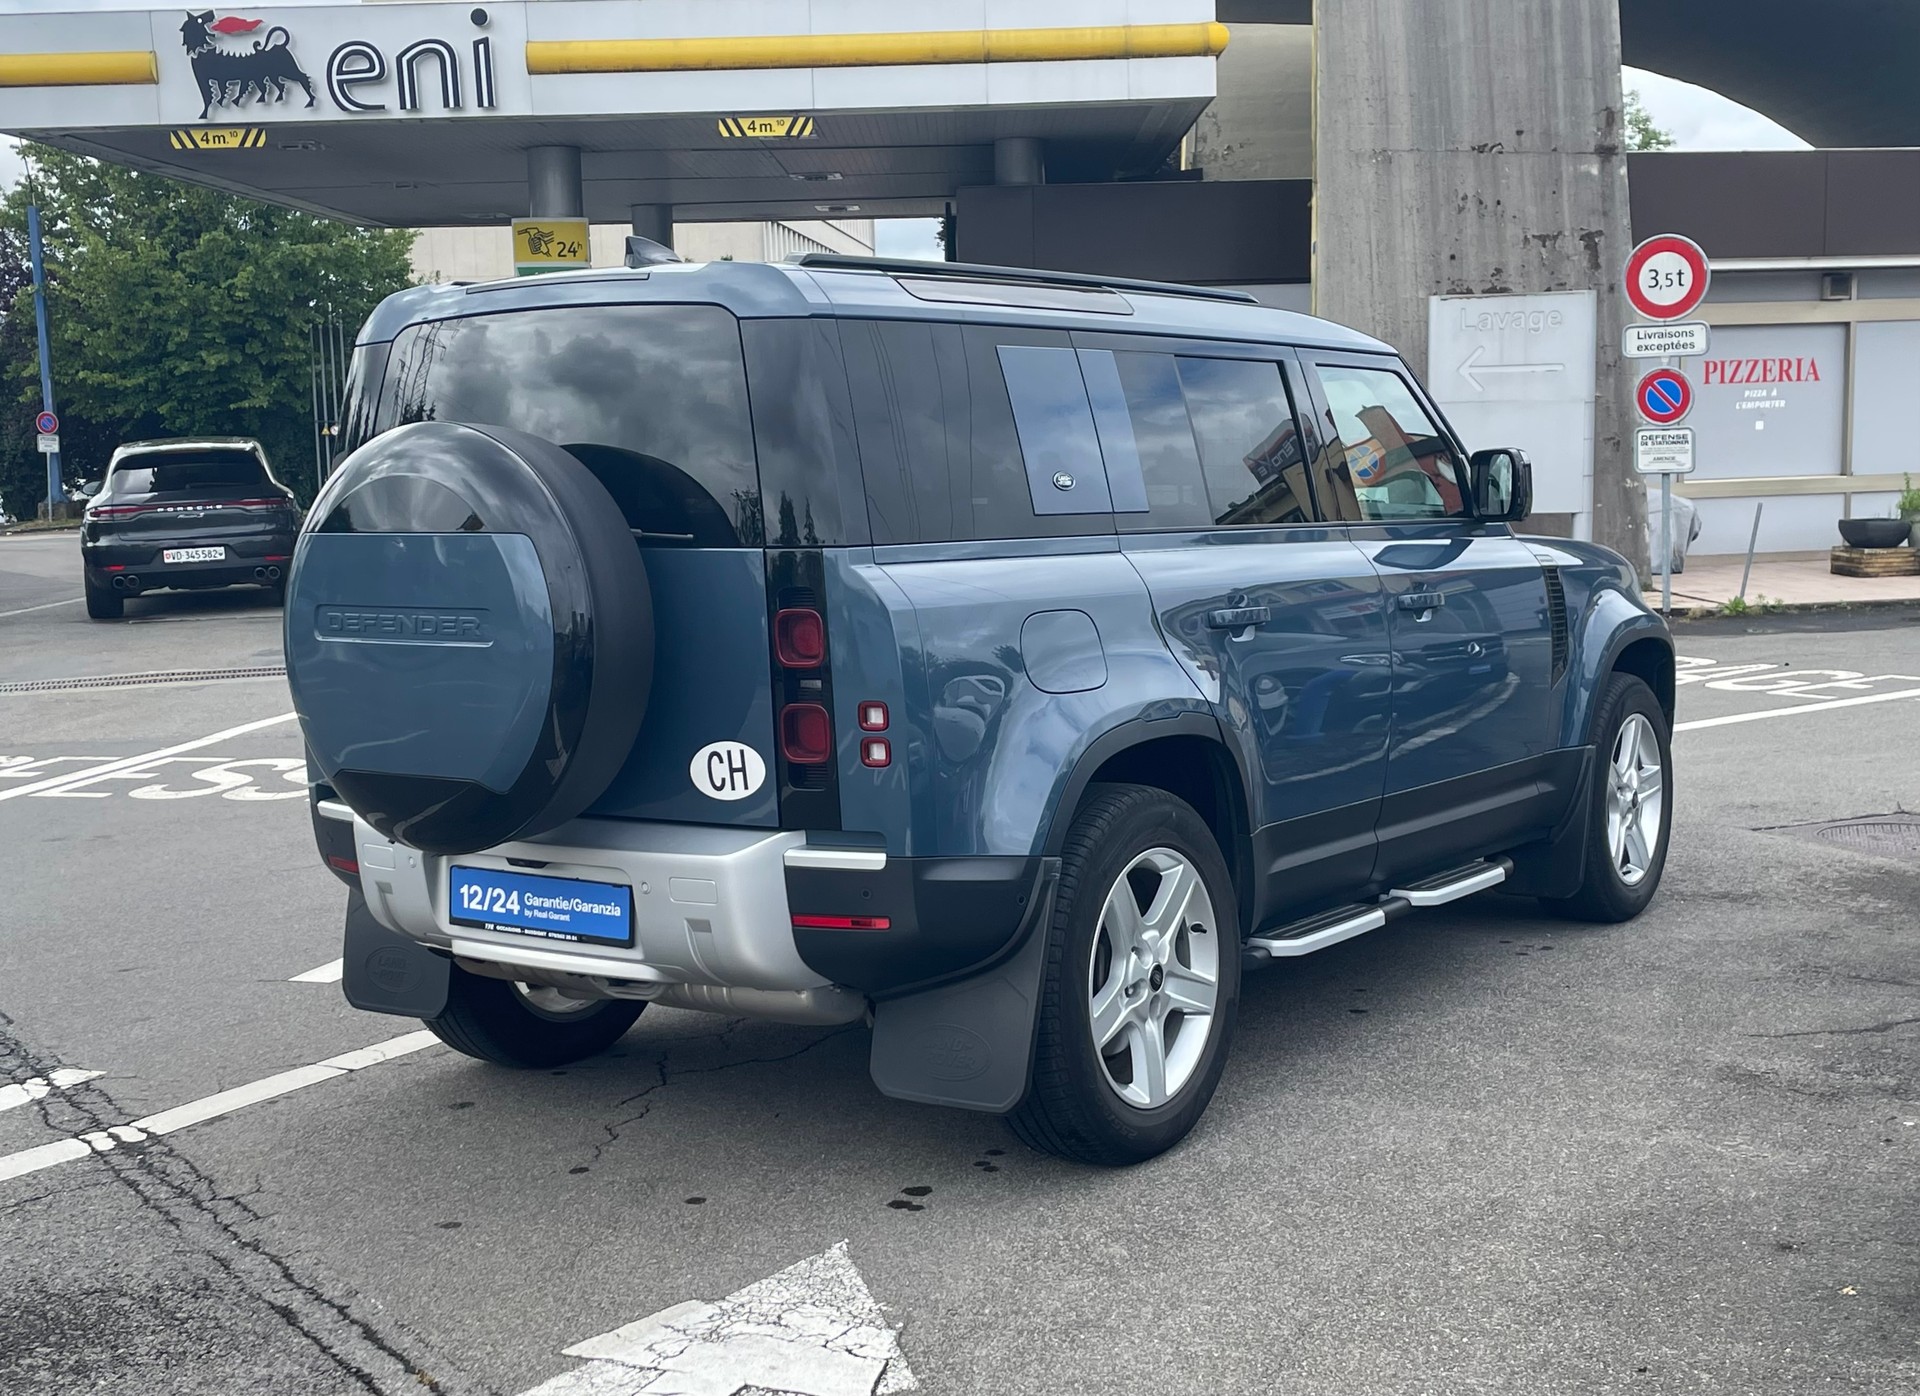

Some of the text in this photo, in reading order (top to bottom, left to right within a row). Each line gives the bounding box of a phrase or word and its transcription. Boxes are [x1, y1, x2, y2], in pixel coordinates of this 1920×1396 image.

[326, 7, 496, 111] eni
[556, 241, 583, 258] 24h
[1460, 307, 1562, 334] Lavage
[1636, 329, 1695, 340] Livraisons
[1636, 341, 1696, 352] exceptées
[1703, 356, 1820, 385] PIZZERIA
[1744, 389, 1767, 398] PIZZA
[1735, 400, 1786, 410] L'EMPORTER
[157, 504, 223, 513] PORSCHE
[327, 612, 482, 636] DEFENDER
[707, 748, 749, 792] CH
[459, 884, 621, 917] 12/24 Garantie/Garanzia
[524, 907, 571, 922] by Real Garant
